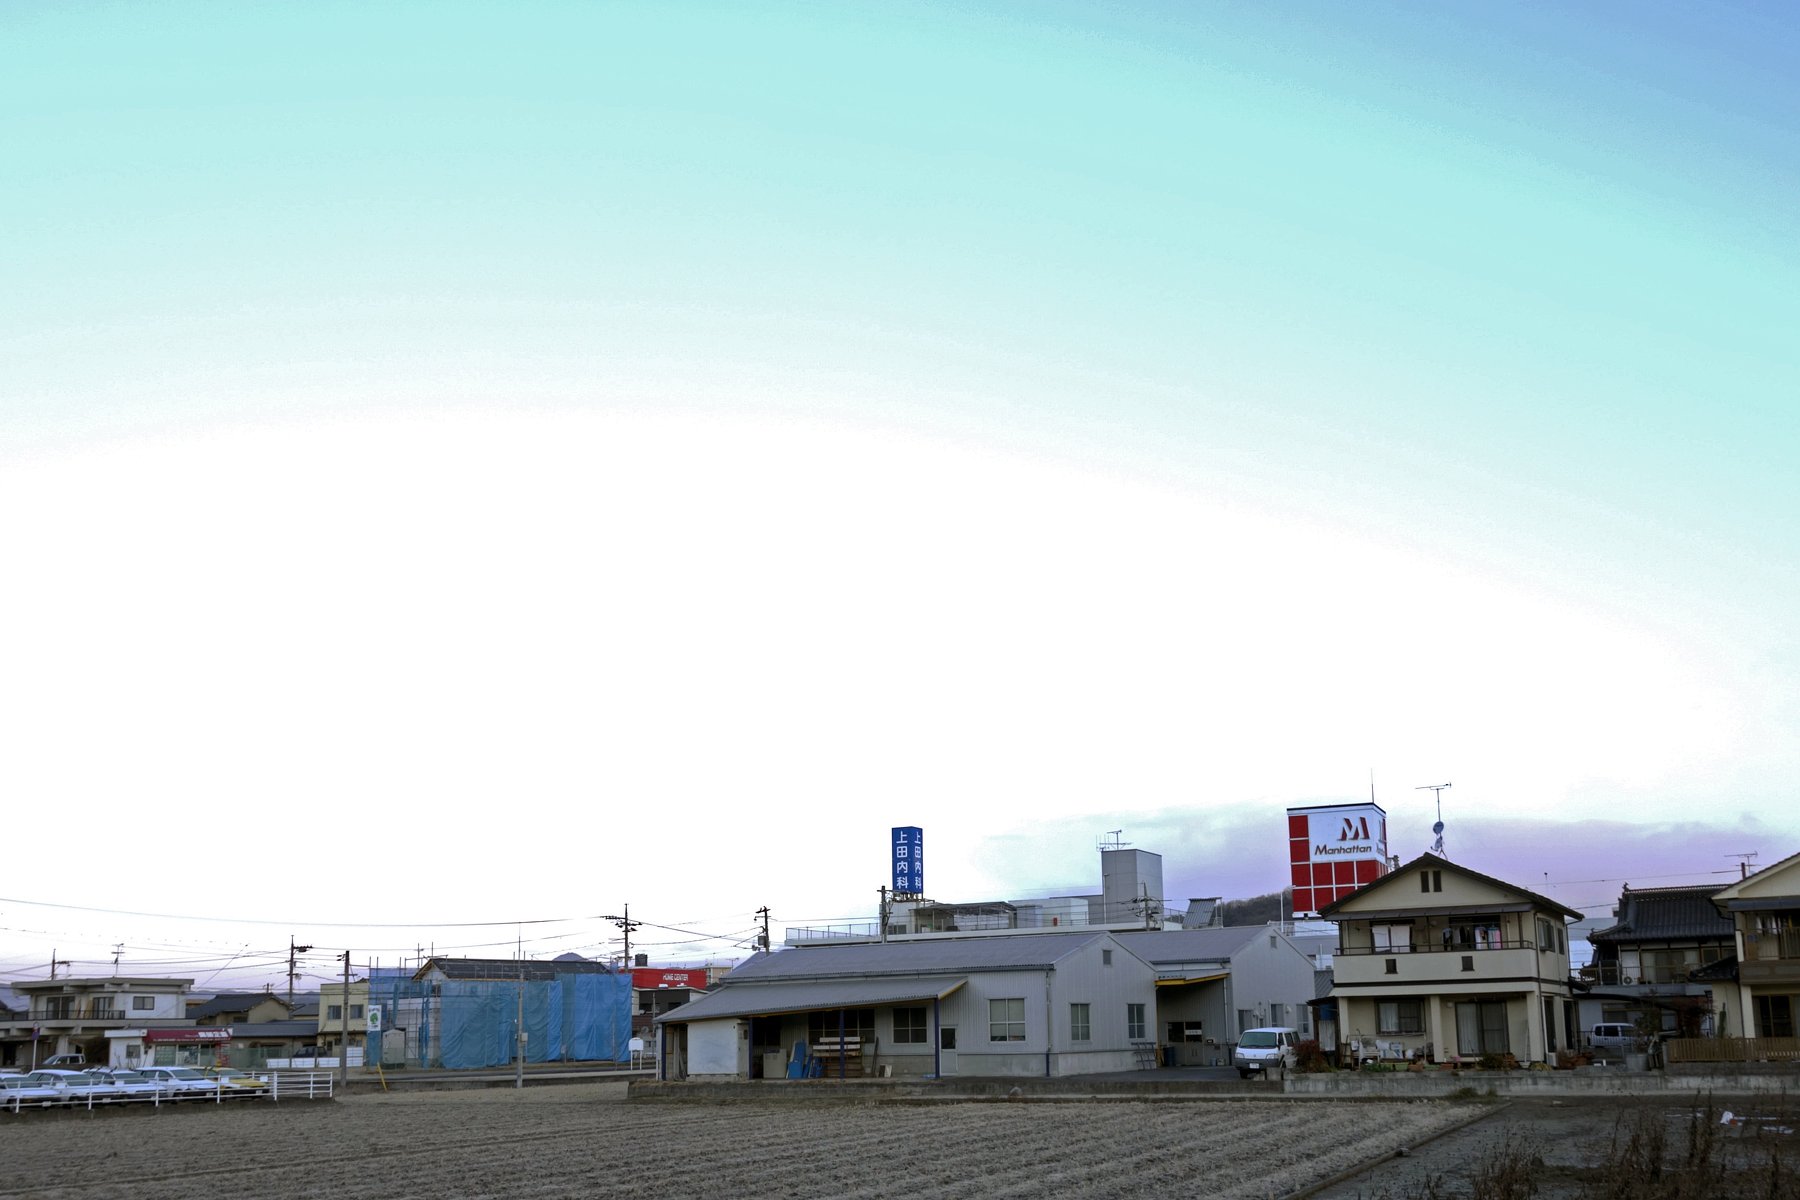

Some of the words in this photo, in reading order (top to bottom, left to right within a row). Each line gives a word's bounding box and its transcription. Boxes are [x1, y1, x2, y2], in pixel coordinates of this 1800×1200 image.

[1315, 844, 1372, 856] Manhattan
[896, 830, 908, 889] 上田内科
[674, 973, 688, 981] CENTER
